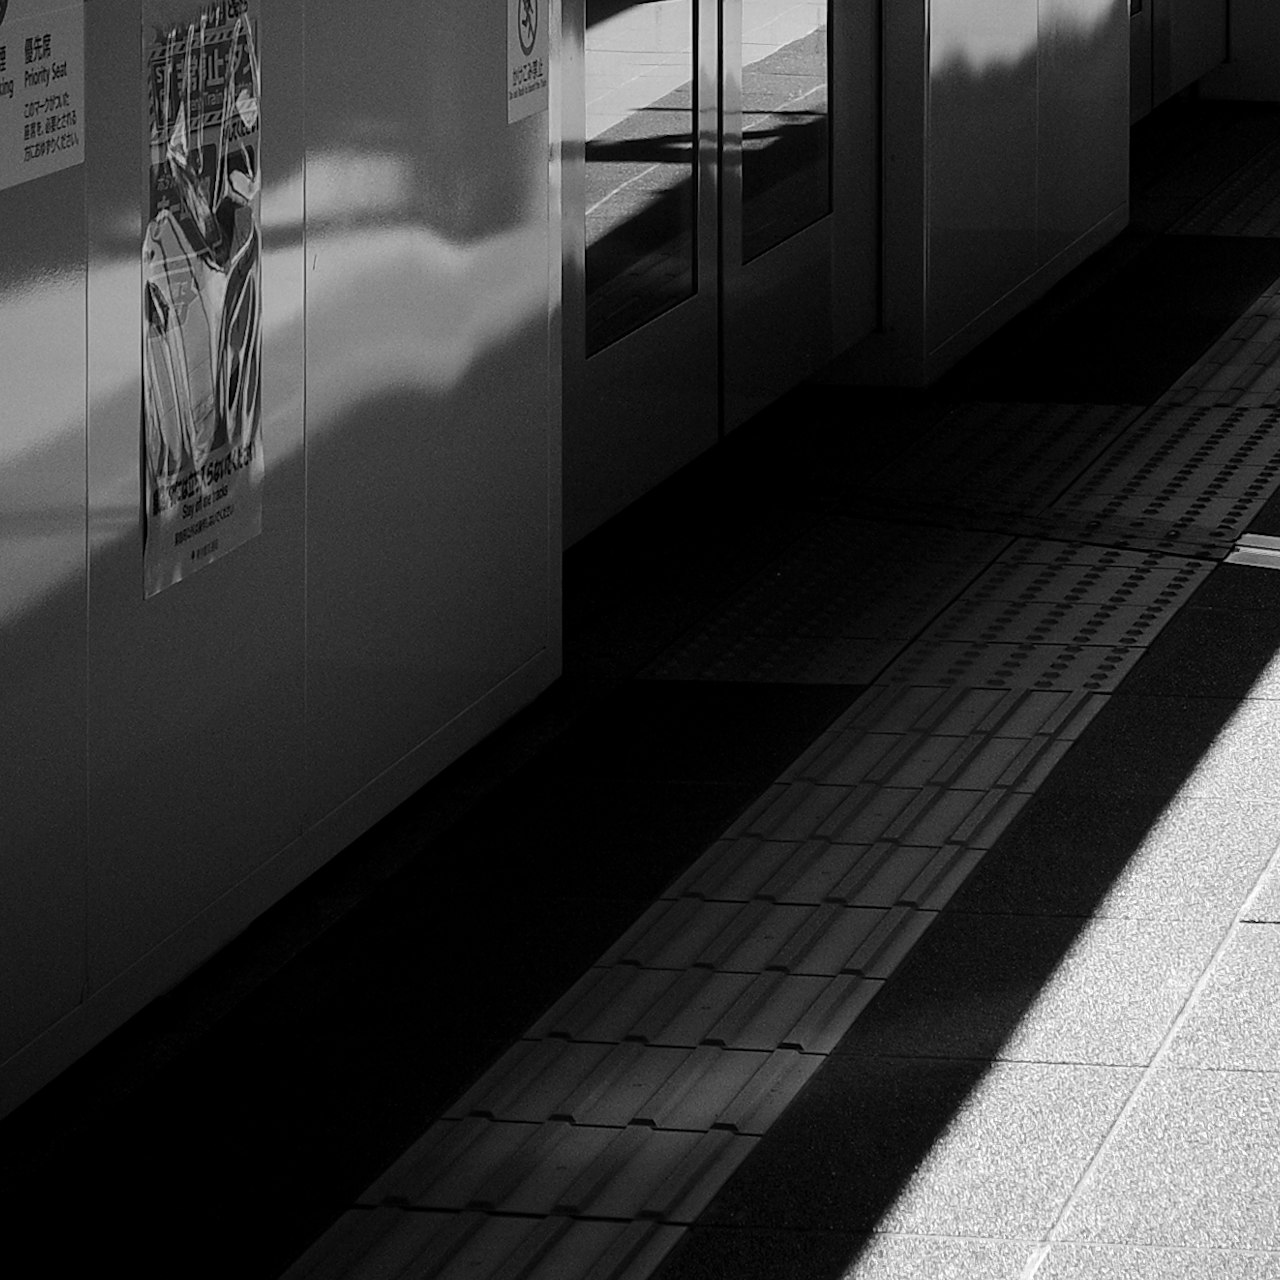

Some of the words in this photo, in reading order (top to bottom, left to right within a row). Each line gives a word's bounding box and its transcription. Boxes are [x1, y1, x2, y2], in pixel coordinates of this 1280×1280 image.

[24, 34, 52, 65] 優先席
[24, 66, 51, 88] Priority
[52, 60, 68, 81] Seat
